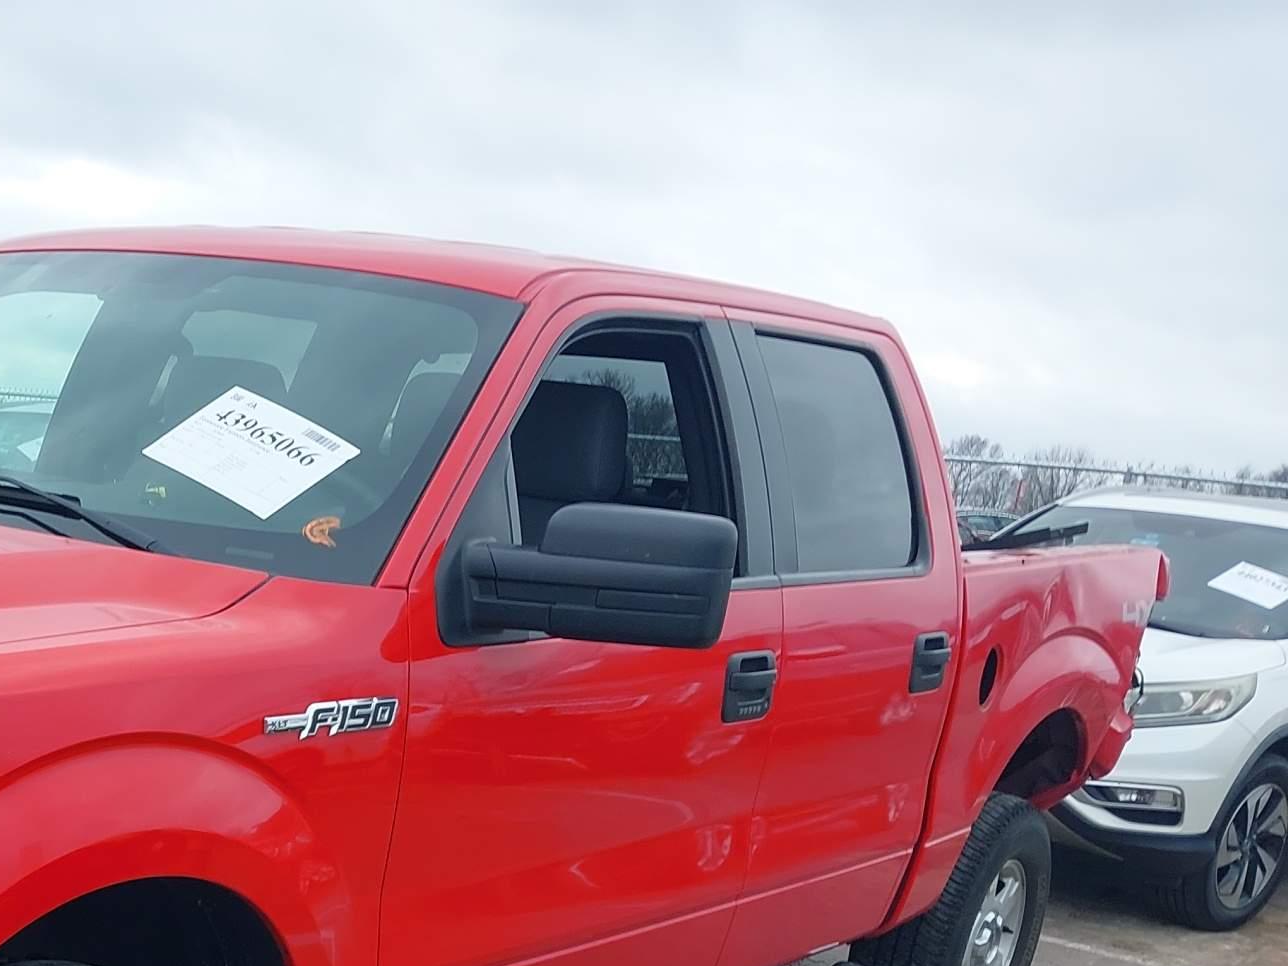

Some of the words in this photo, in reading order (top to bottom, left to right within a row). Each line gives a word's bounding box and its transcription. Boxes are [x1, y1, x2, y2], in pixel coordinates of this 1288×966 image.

[215, 409, 321, 467] 43965066
[270, 719, 289, 729] XLT
[300, 697, 399, 740] F-150
